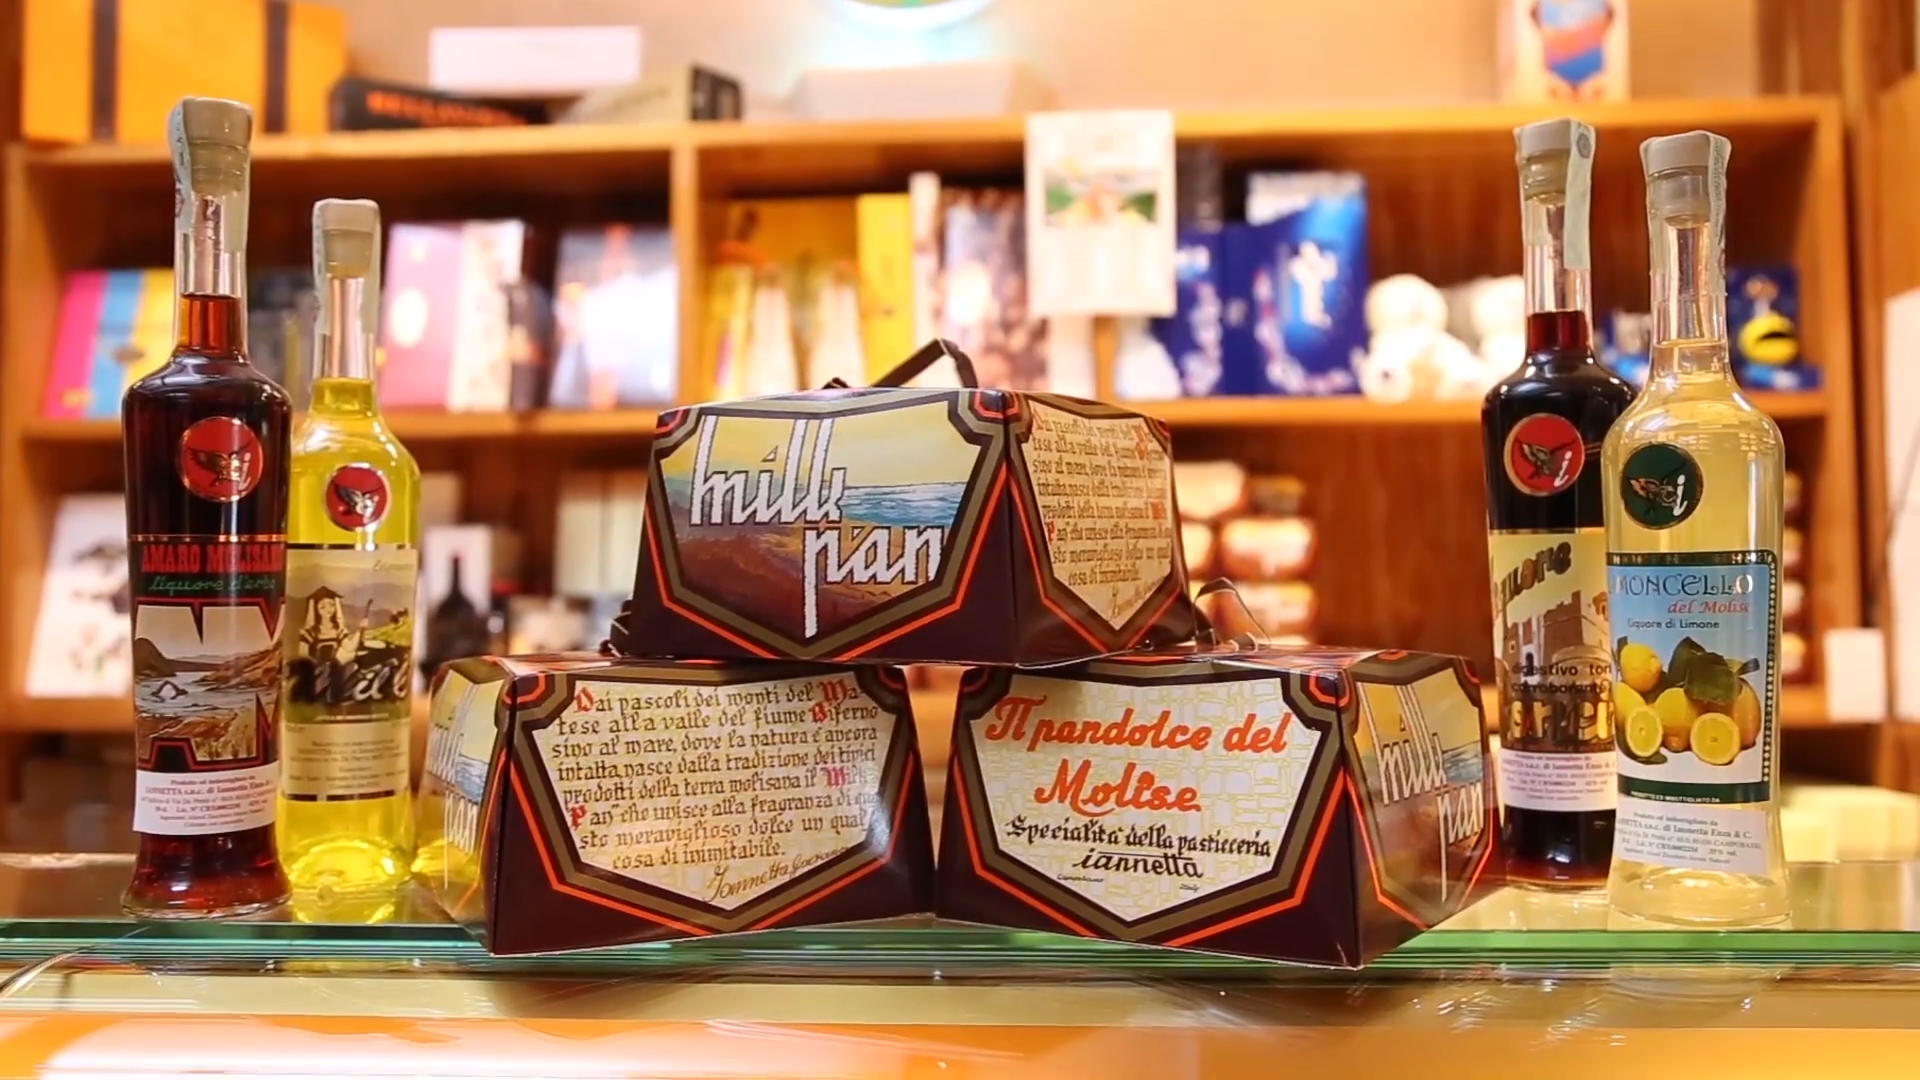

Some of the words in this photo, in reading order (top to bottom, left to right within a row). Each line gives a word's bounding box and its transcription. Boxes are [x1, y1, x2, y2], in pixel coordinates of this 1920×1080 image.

[142, 543, 200, 573] AMARO
[803, 525, 945, 639] pan
[1667, 599, 1696, 614] del
[1665, 618, 1676, 629] di
[1679, 619, 1720, 629] Limone
[574, 687, 614, 713] Dai
[618, 688, 690, 716] pascoli
[694, 687, 720, 708] dei
[785, 682, 814, 703] del
[557, 714, 601, 736] tese
[609, 711, 657, 733] alla
[663, 709, 711, 730] valle
[718, 705, 746, 727] del
[754, 704, 808, 732] fiume
[1027, 708, 1210, 752] pandolce
[1222, 711, 1293, 753] del
[552, 737, 594, 761] sino
[599, 735, 620, 757] al
[680, 732, 722, 752] dove
[728, 729, 746, 749] la
[677, 752, 721, 775] dalla
[725, 748, 809, 771] tradizione
[814, 744, 836, 766] dei
[563, 779, 634, 811] prodotti
[638, 776, 681, 800] della
[684, 777, 725, 797] terra
[729, 770, 802, 796] molisana
[804, 766, 817, 788] il
[620, 801, 649, 824] che
[653, 798, 709, 821] unisce
[711, 794, 746, 817] alla
[751, 793, 833, 819] fragranza
[836, 788, 852, 807] di
[579, 830, 609, 850] sto
[615, 819, 741, 849] meraviglioso
[749, 813, 794, 836] dolce
[801, 815, 824, 833] un
[1124, 822, 1174, 850] della
[1176, 829, 1272, 859] pasticceria
[612, 852, 655, 870] cosa
[660, 844, 678, 866] di
